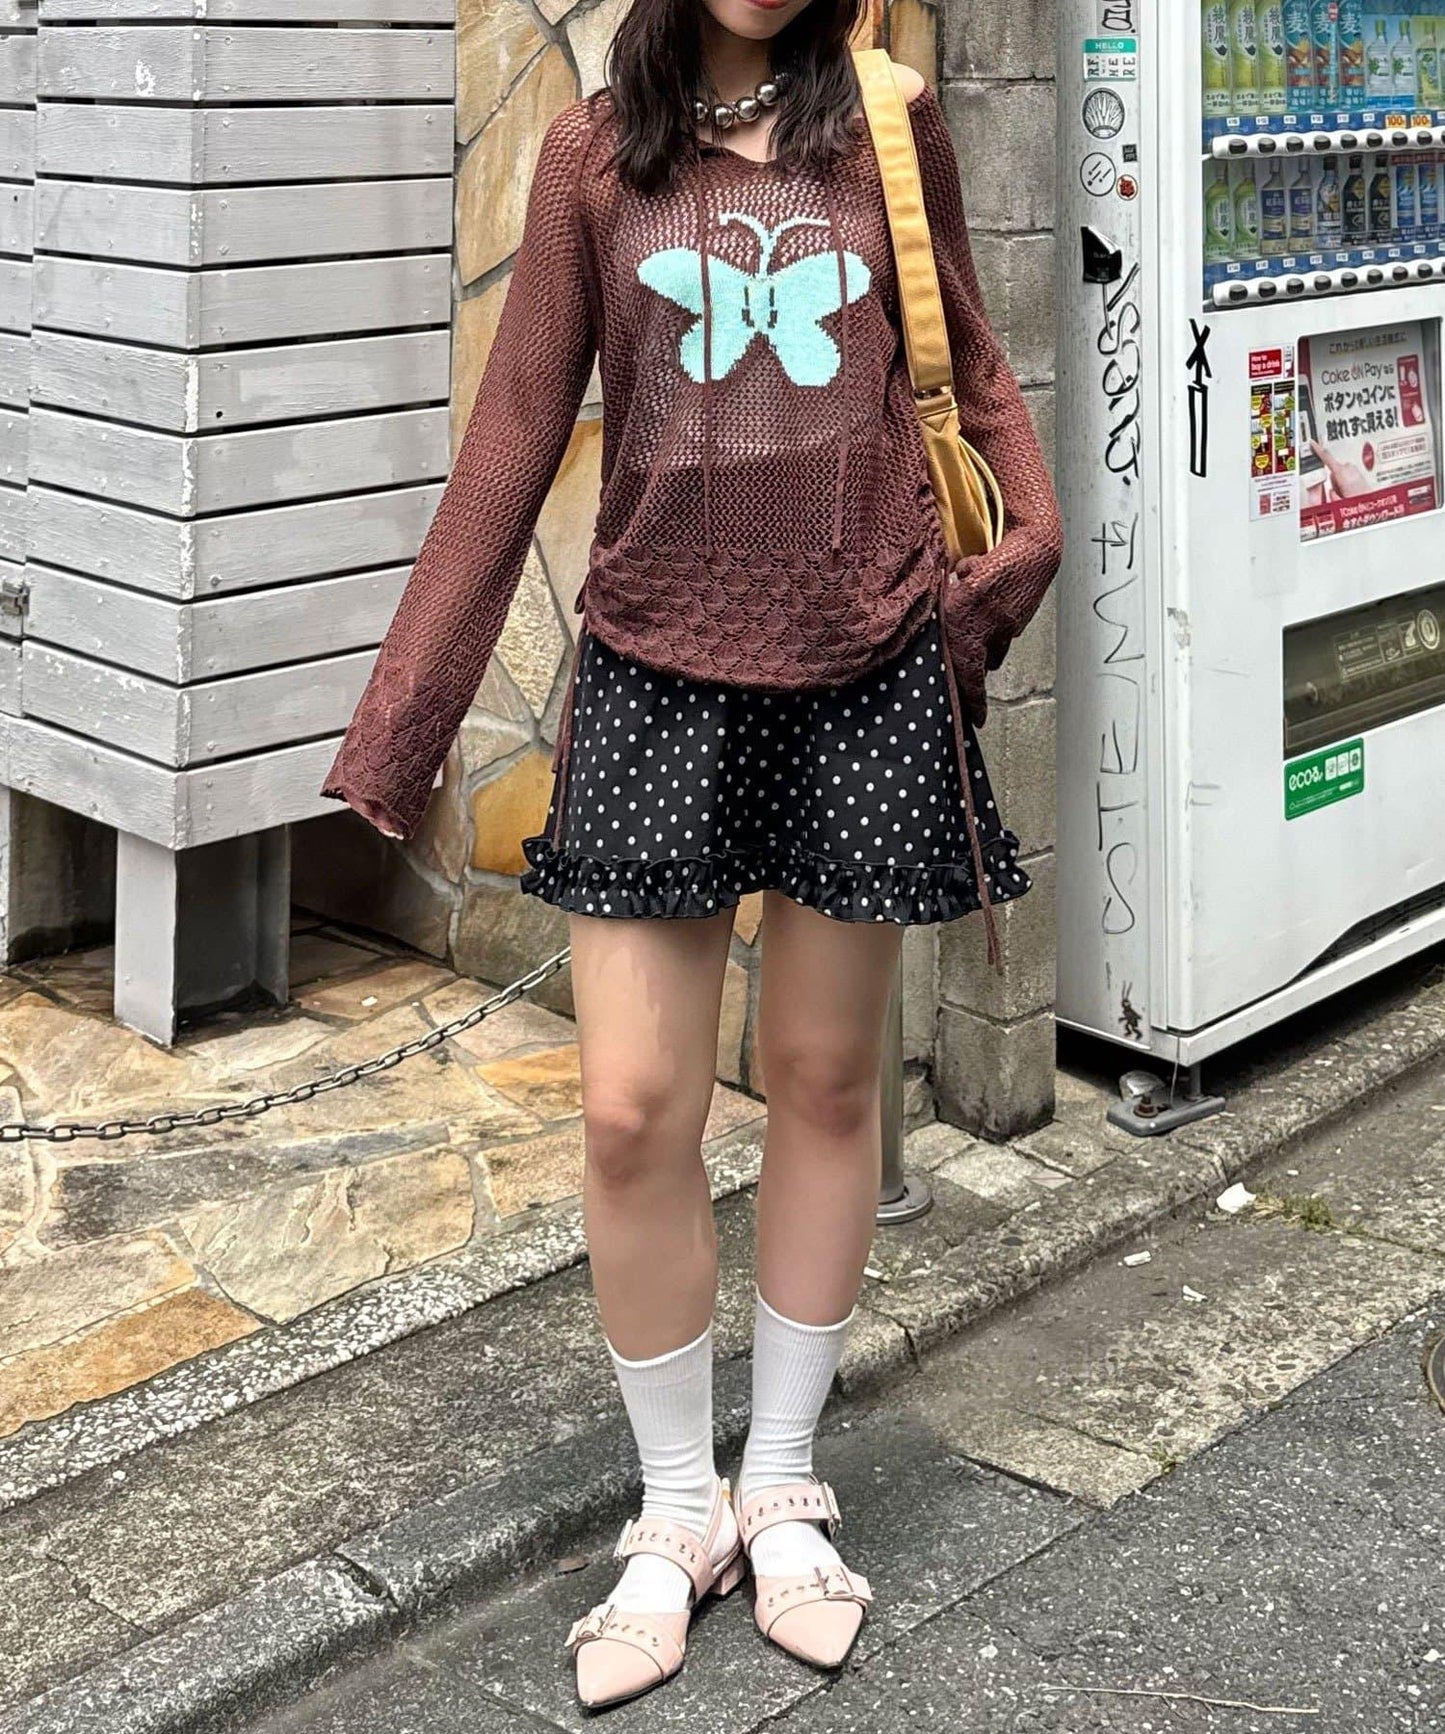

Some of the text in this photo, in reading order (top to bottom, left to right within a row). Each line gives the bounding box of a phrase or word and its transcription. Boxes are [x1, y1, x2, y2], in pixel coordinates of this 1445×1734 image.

[1321, 368, 1350, 385] Coke
[1364, 362, 1381, 379] Pay
[1323, 385, 1395, 413] ボタンやコインに
